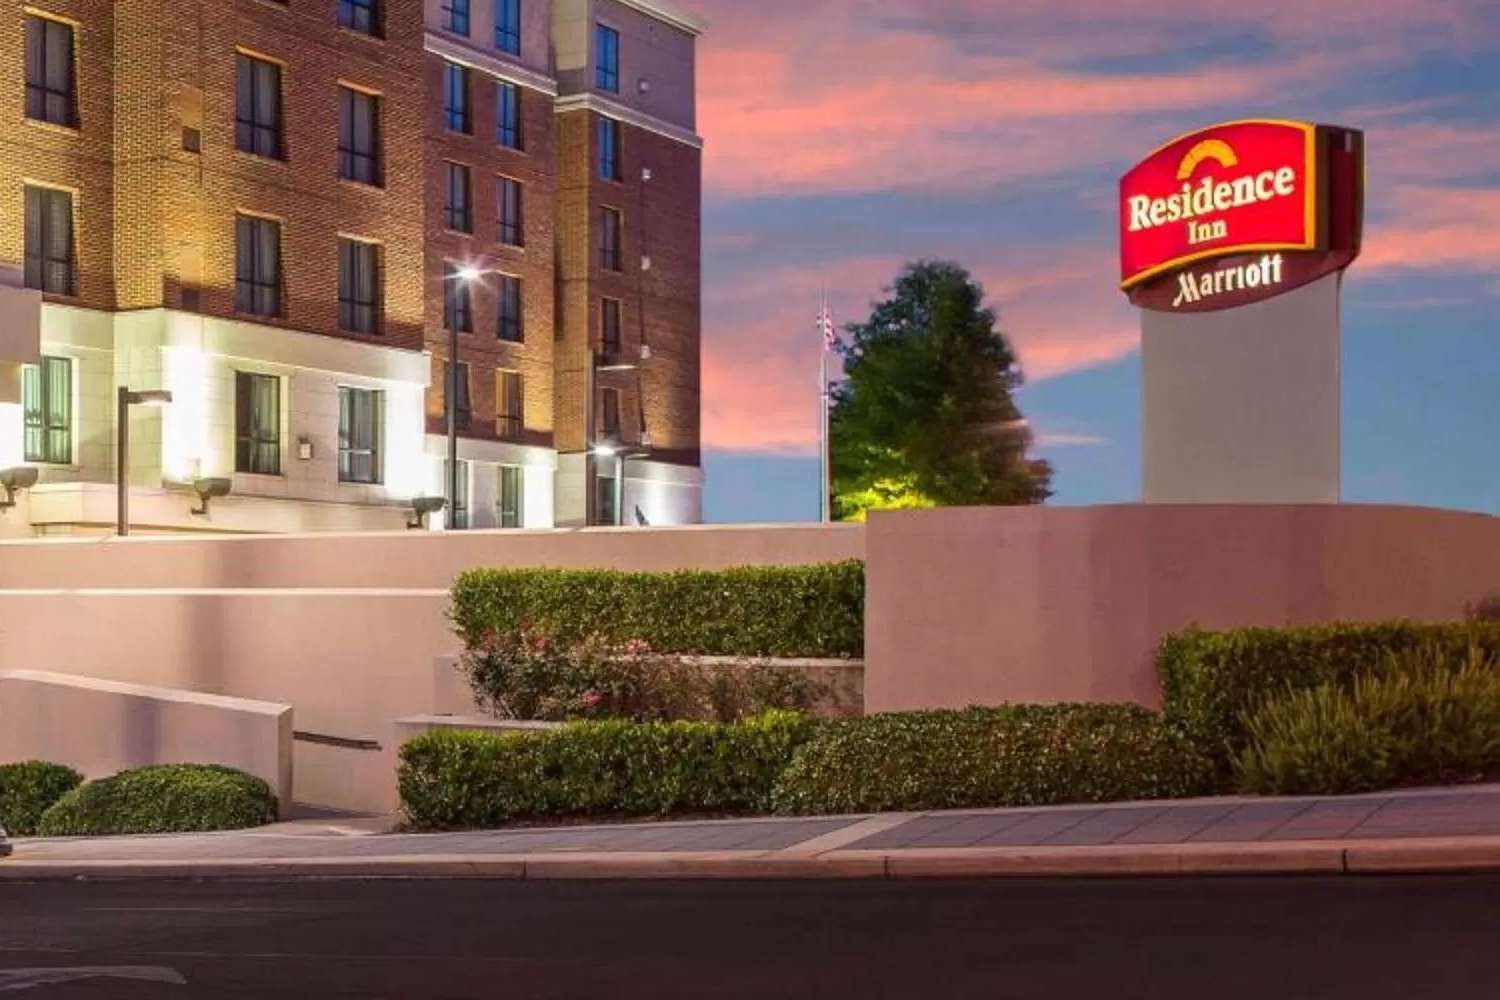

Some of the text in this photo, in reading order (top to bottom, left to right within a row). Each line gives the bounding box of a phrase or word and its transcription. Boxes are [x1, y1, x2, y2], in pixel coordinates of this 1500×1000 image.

[1128, 165, 1296, 232] Residence
[1187, 219, 1228, 245] Inn
[1172, 252, 1283, 307] Marriott
